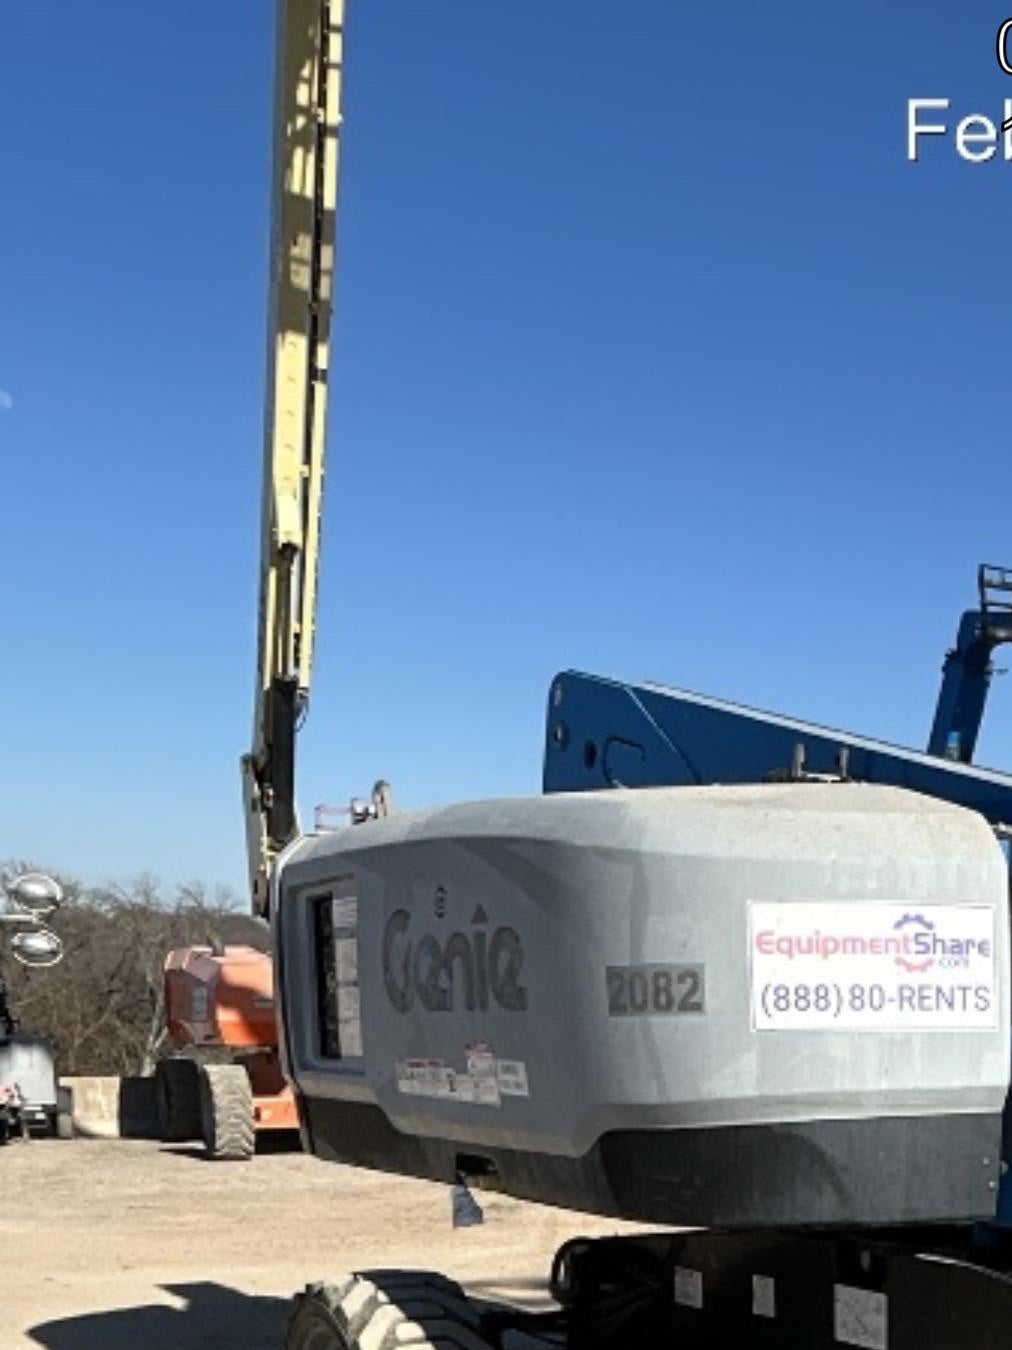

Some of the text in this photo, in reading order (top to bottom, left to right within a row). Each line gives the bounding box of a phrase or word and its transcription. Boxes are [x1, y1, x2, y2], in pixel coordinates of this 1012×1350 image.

[382, 903, 529, 1014] Genie
[755, 929, 991, 961] EquipmentShare
[606, 969, 703, 1013] 2082
